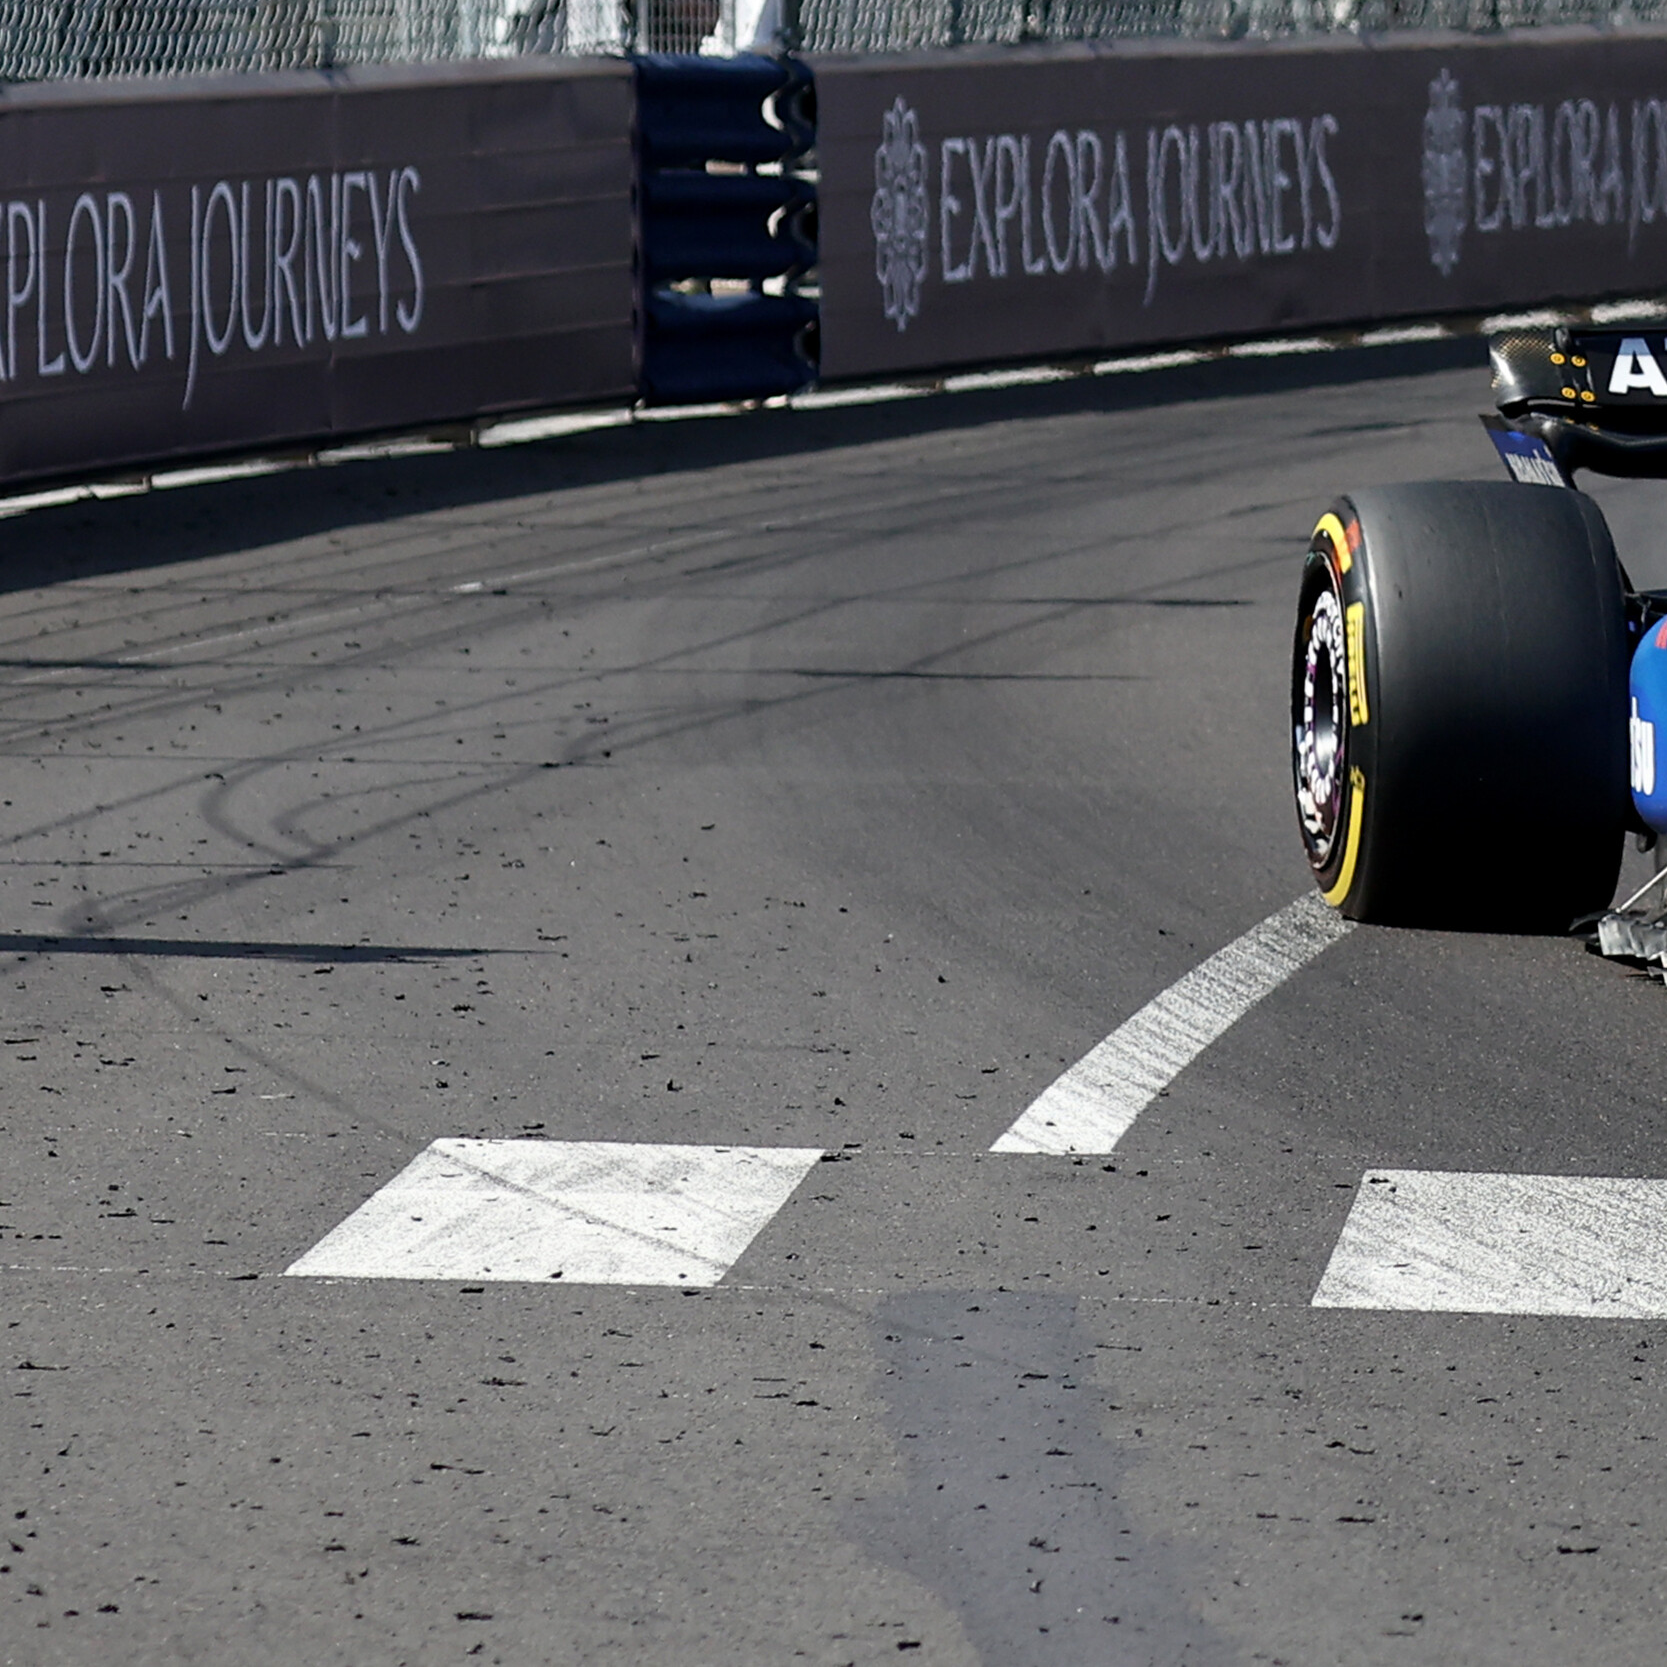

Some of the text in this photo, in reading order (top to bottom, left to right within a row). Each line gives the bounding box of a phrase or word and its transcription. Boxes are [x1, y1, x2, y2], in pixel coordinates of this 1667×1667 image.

[941, 114, 1342, 306] EXPLORA JOURNEYS
[1472, 98, 1625, 232] EXPLORA
[182, 165, 425, 411] JOURNEYS
